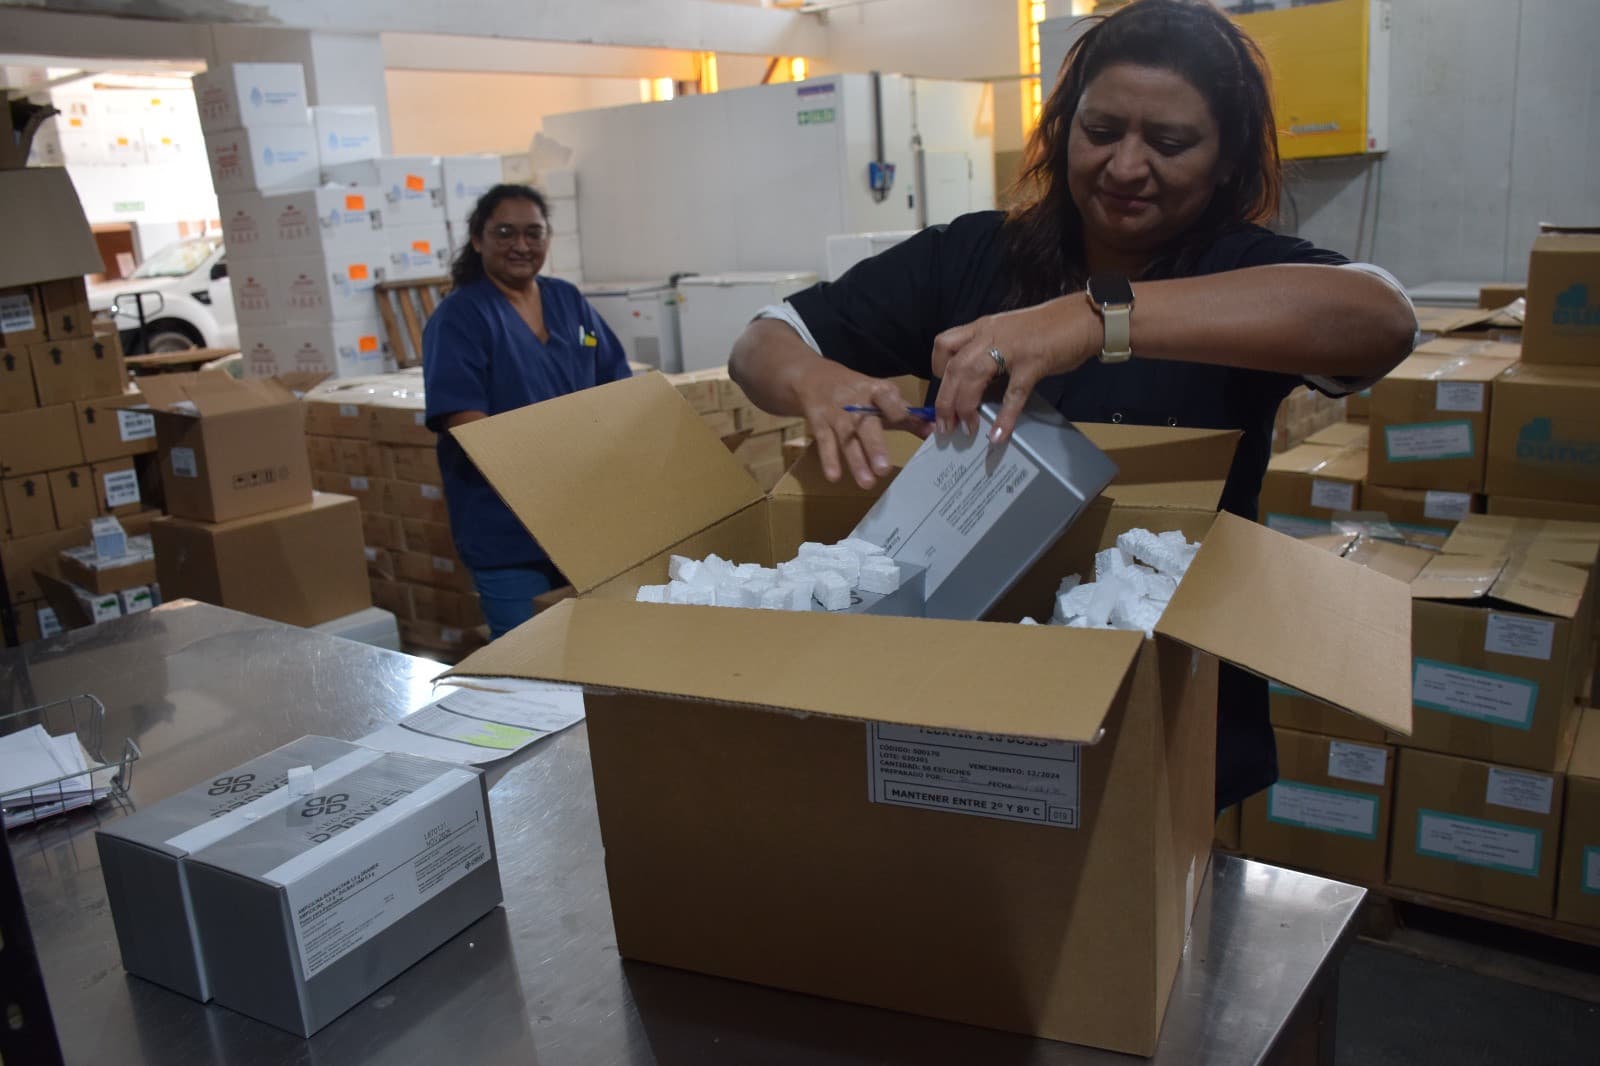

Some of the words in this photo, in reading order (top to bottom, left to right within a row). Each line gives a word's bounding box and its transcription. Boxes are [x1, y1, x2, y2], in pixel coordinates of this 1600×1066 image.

[880, 760, 920, 771] CANTIDAD:
[933, 767, 971, 777] ESTUCHES
[880, 768, 923, 778] PREPARADO
[969, 763, 1025, 776] VENCIMIENTO:
[1027, 770, 1060, 780] 12/2024
[892, 789, 949, 803] MANTENER
[953, 797, 987, 809] ENTRE
[1006, 803, 1013, 812] Y
[1033, 807, 1041, 816] C
